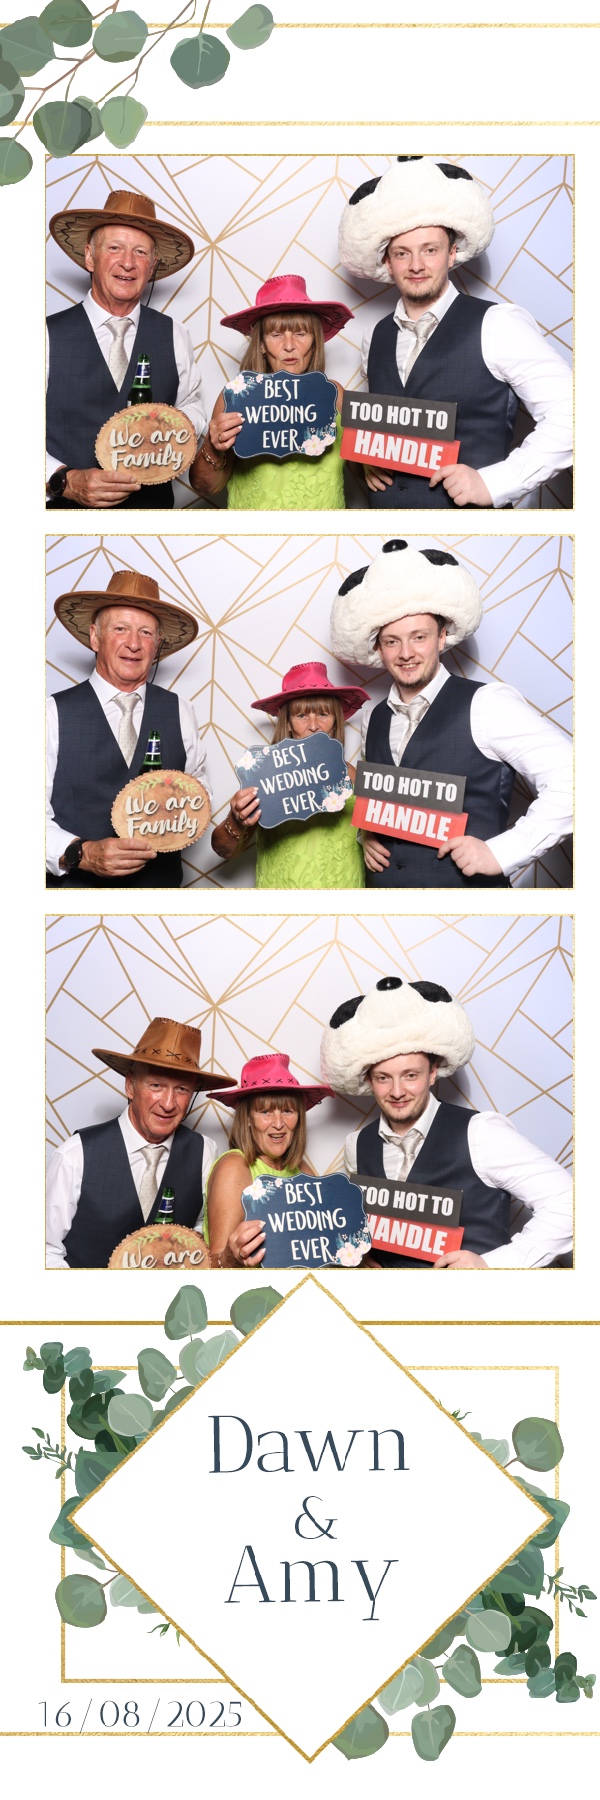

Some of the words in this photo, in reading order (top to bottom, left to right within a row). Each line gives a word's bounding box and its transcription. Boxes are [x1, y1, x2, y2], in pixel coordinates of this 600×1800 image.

[264, 379, 300, 401] BEST
[245, 404, 317, 424] WEDDING
[350, 401, 383, 422] TOO
[386, 405, 423, 425] HOT
[426, 409, 448, 430] TO
[109, 422, 143, 448] We
[150, 429, 191, 445] are
[262, 429, 302, 451] EVER
[110, 443, 184, 471] Family
[354, 429, 443, 471] HANDLE
[272, 743, 307, 769] BEST
[260, 763, 330, 796] WEDDING
[363, 771, 394, 793] TOO
[397, 775, 433, 797] HOT
[435, 781, 457, 802] TO
[125, 788, 159, 815] We
[165, 795, 204, 811] are
[282, 790, 322, 815] EVER
[126, 810, 199, 838] Family
[365, 799, 451, 842] HANDLE
[285, 1182, 323, 1206] BEST
[359, 1185, 390, 1207] OO
[392, 1190, 430, 1213] HOT
[431, 1196, 454, 1216] TO
[268, 1208, 347, 1233] WEDDING
[122, 1245, 157, 1268] We
[163, 1249, 205, 1266] are
[290, 1236, 335, 1263] EVER
